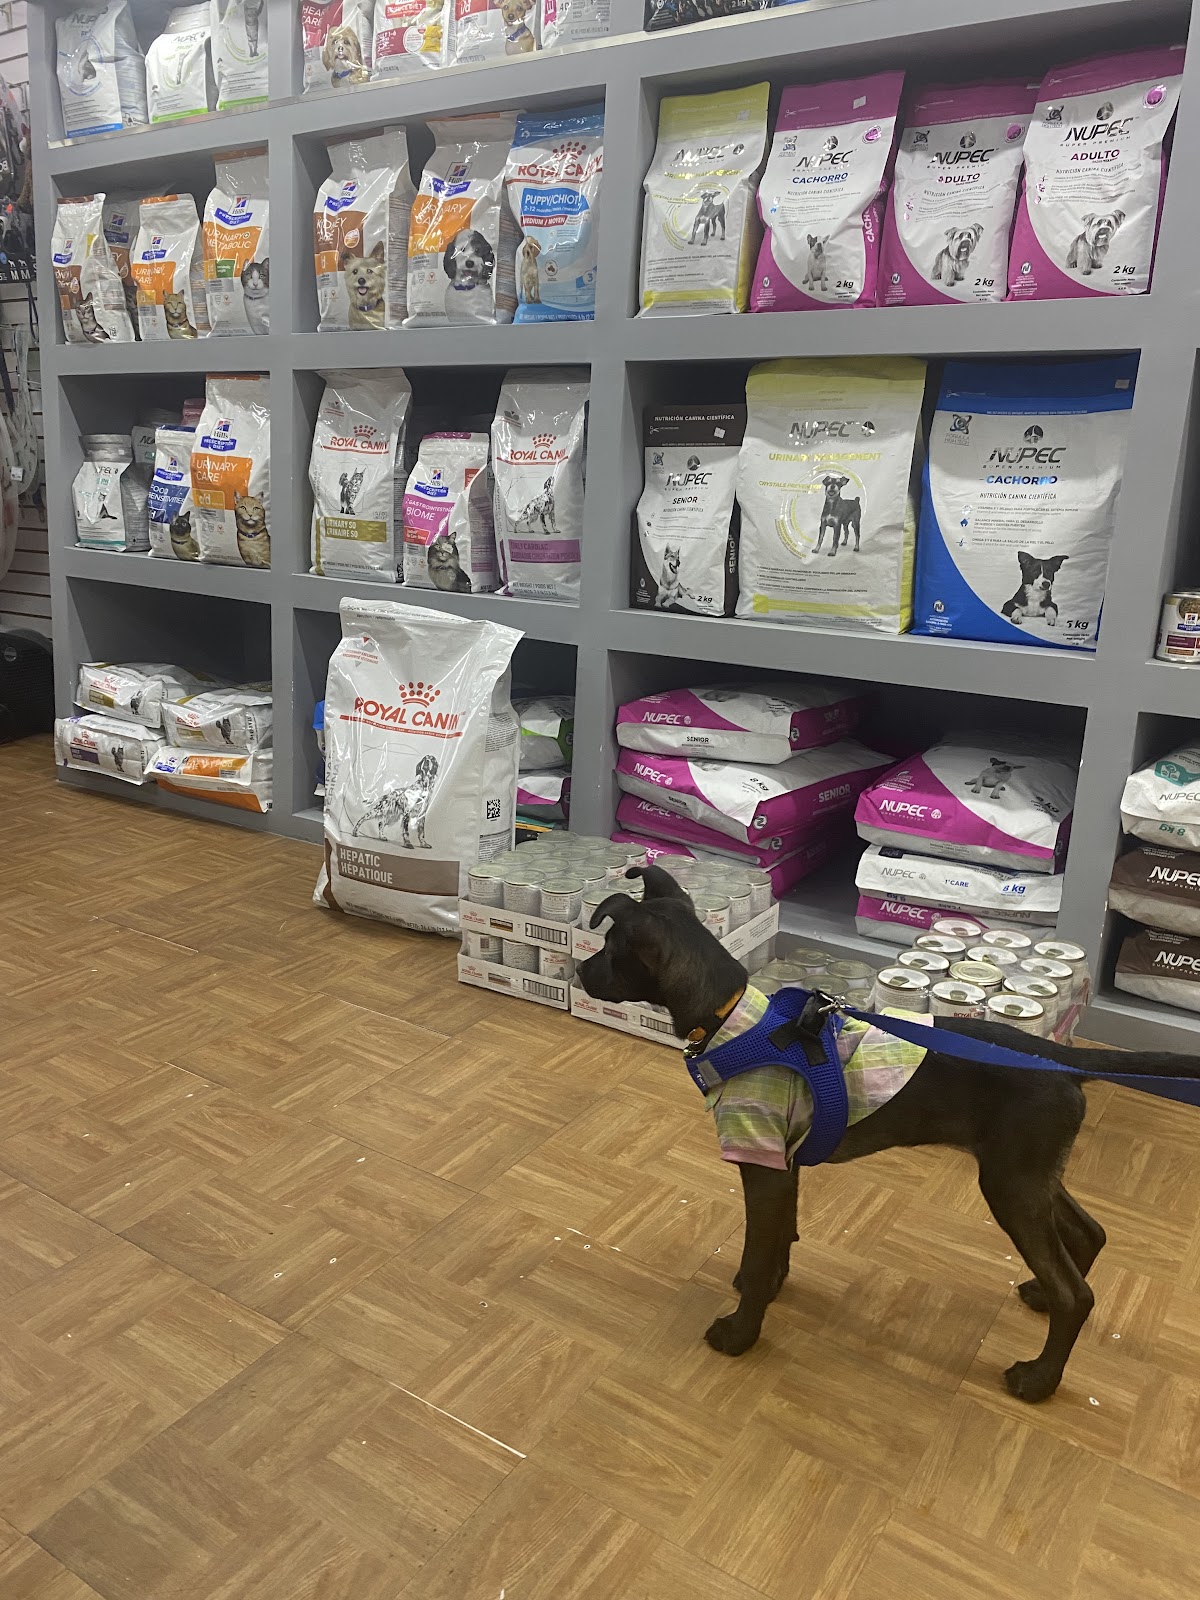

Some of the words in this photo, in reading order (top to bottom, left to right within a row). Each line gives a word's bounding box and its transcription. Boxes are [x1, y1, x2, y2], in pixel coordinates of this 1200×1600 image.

[1064, 116, 1134, 141] NUPEC
[930, 149, 995, 164] NUPEC
[1070, 149, 1120, 161] ADULTO
[792, 173, 848, 184] CACHORRO
[1122, 265, 1136, 275] kg
[843, 280, 854, 289] kg
[974, 278, 981, 286] 2
[982, 278, 994, 287] kg
[788, 420, 855, 439] NUPEC
[330, 437, 357, 447] ROYAL
[510, 449, 537, 461] ROYAL
[768, 452, 810, 462] URINARY
[813, 452, 882, 462] MANAGEMENT
[985, 447, 1067, 464] NUPEC
[196, 459, 237, 472] URINARY
[196, 471, 220, 482] CARE
[666, 472, 713, 487] NUPEC
[986, 475, 1058, 485] CACHORRO
[672, 496, 698, 505] SENIOR
[980, 491, 1007, 499] NUTRICIÓN
[1028, 492, 1056, 500] CIENTÍFICA
[405, 506, 436, 521] BIOME
[326, 519, 347, 528] URINARY
[704, 595, 713, 603] kg
[1074, 620, 1089, 630] kg
[354, 696, 407, 725] ROYAL
[411, 710, 459, 731] CANIN
[642, 711, 682, 725] NUPEC
[686, 735, 710, 744] SENIOR
[633, 762, 666, 783] NUPEC
[818, 783, 851, 803] SENIOR
[878, 799, 928, 818] NUPEC
[1158, 823, 1175, 834] kg
[1176, 828, 1186, 837] 8
[340, 847, 381, 867] HEPATIC
[341, 861, 393, 884] HÉPATIQUE
[880, 867, 917, 879] NUPEC
[1149, 865, 1200, 887] NUPE
[1146, 878, 1170, 886] SUPER
[1002, 884, 1010, 892] 8
[1011, 884, 1026, 894] kg
[880, 901, 929, 920] NUPEC
[1154, 950, 1200, 972] NUPE
